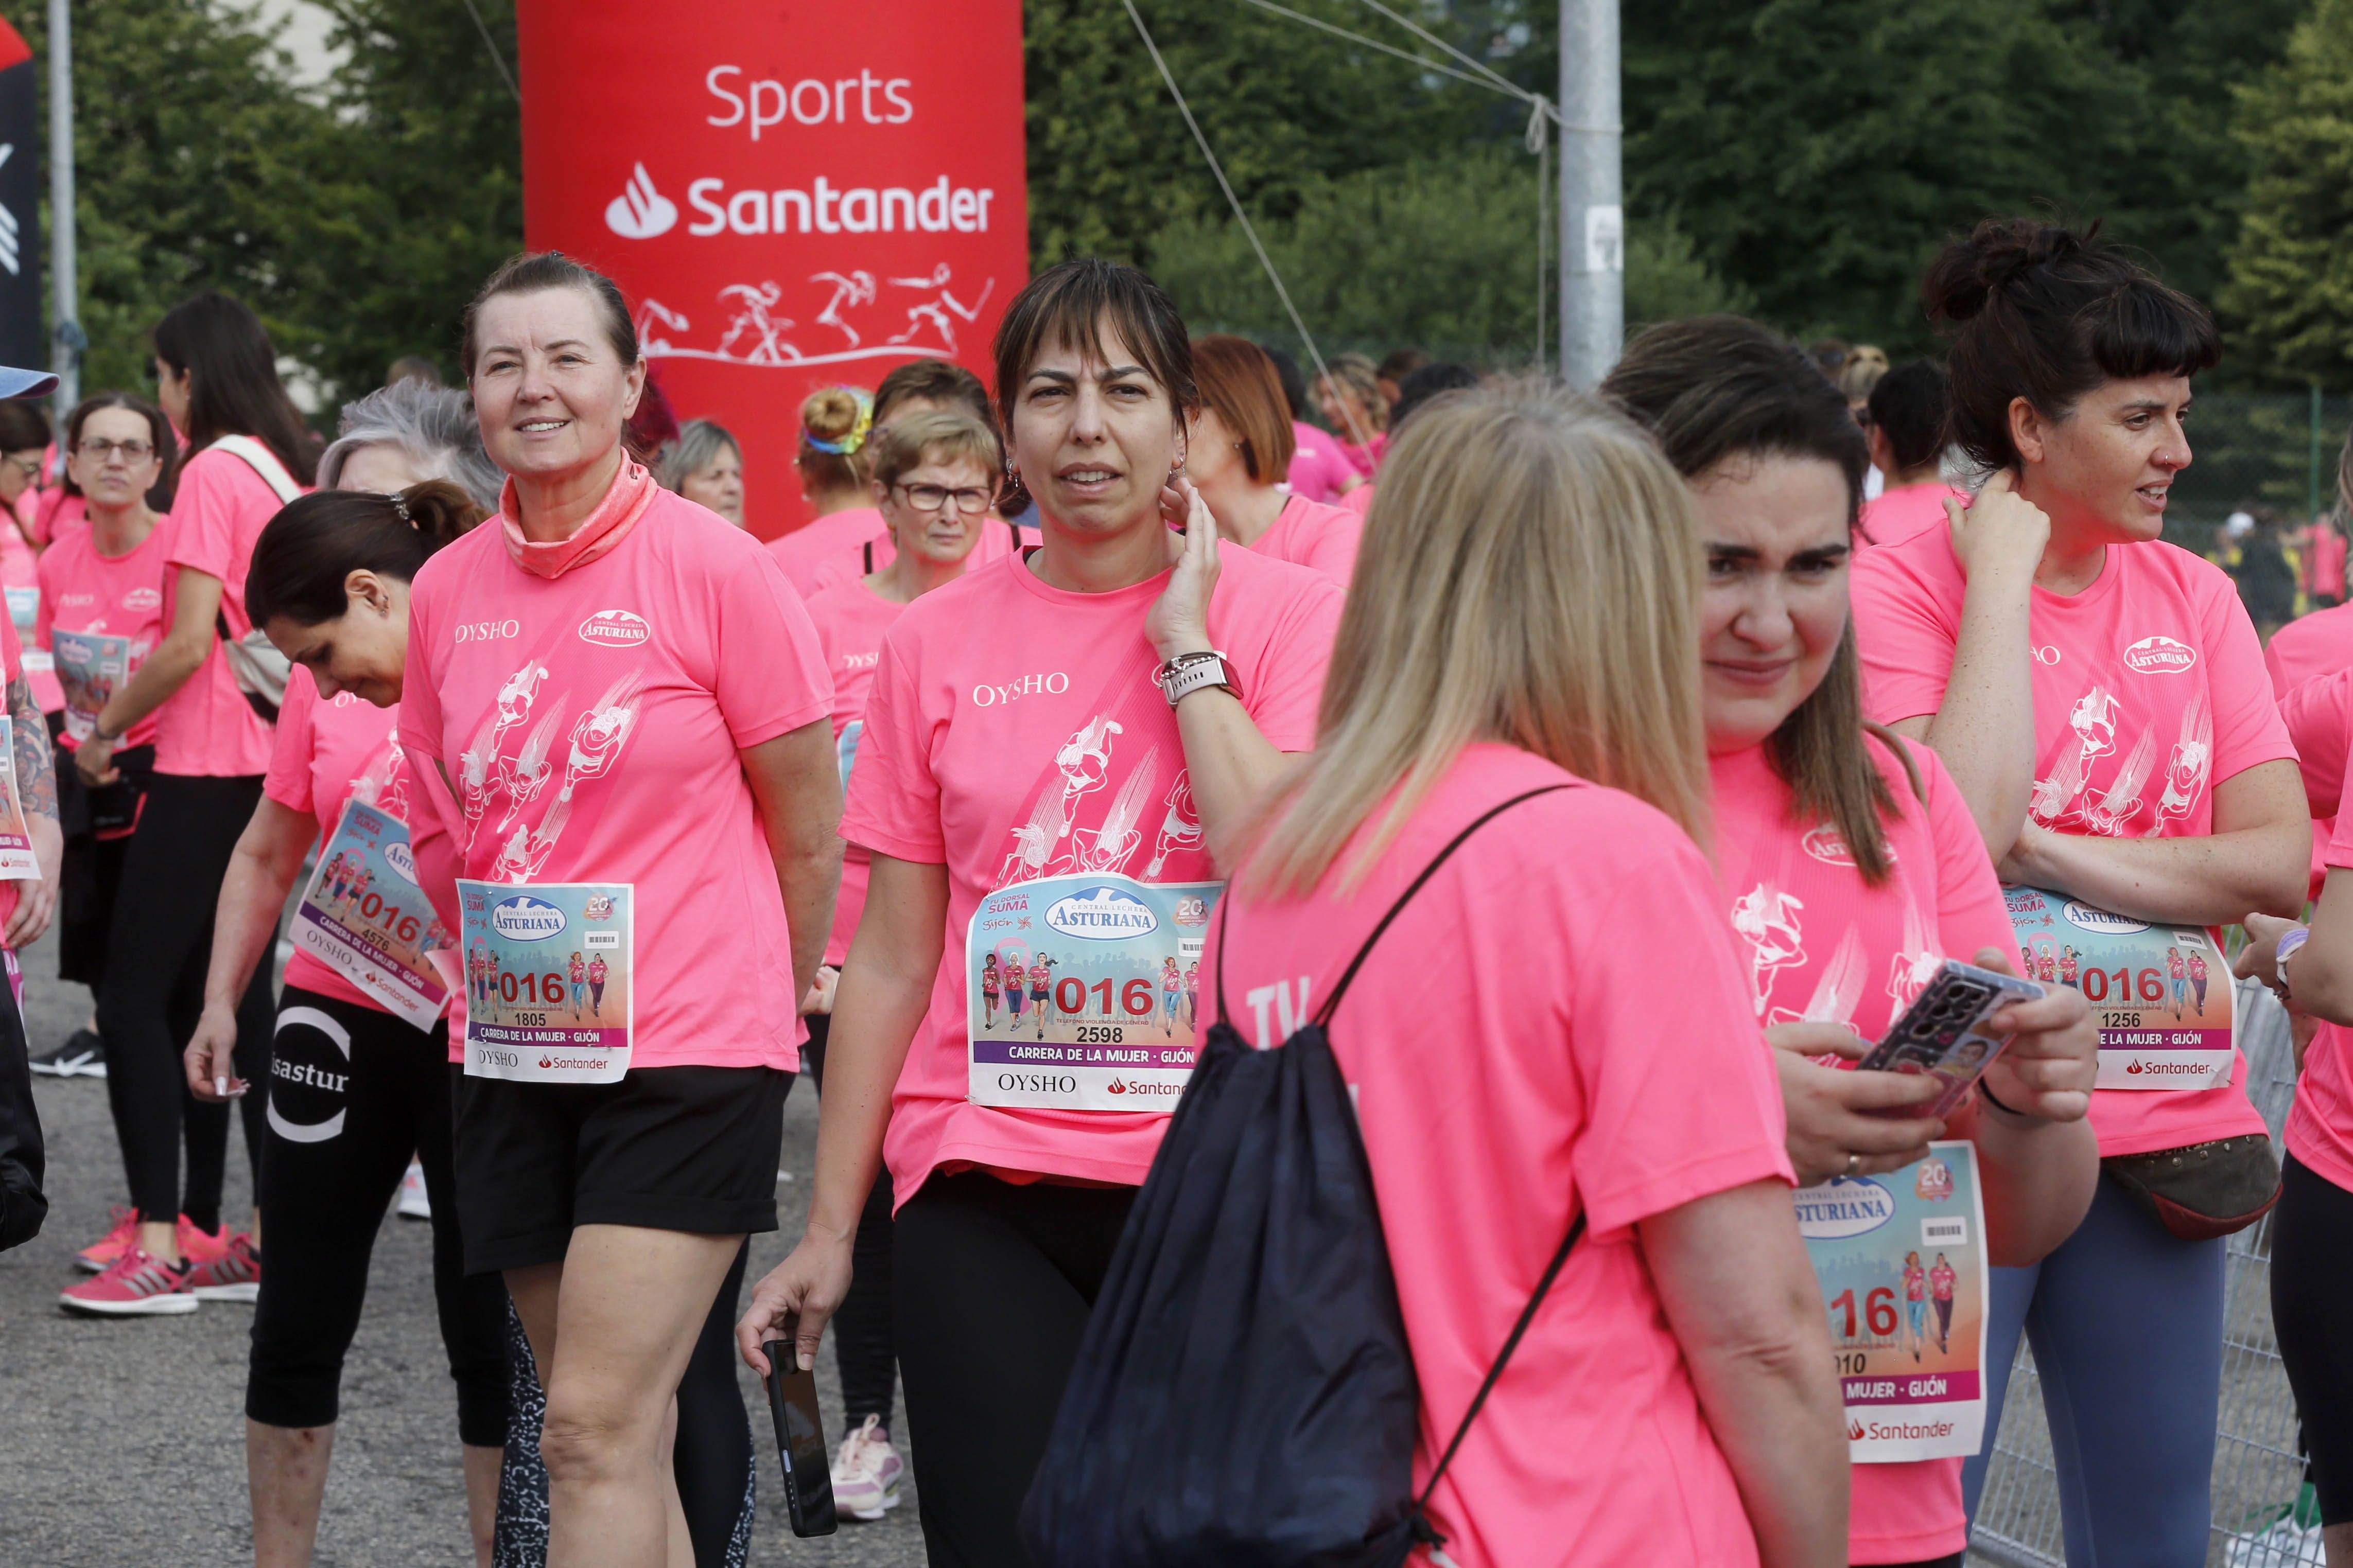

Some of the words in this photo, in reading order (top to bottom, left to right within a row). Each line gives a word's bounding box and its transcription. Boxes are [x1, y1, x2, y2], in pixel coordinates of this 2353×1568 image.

[706, 64, 913, 141] Sports
[688, 175, 994, 236] Santander
[455, 619, 519, 643] OYSHO
[583, 623, 644, 639] ASTURIANA
[2131, 652, 2191, 667] ASTURIANA
[973, 672, 1069, 707] OYSHO
[467, 900, 485, 912] SUMA
[988, 900, 1029, 914] SUMA
[1001, 893, 1030, 903] DORSAL
[2008, 899, 2046, 912] SUMA
[2015, 892, 2043, 904] DORSAL
[361, 892, 421, 942] 016
[496, 911, 560, 929] ASTURIANA
[1053, 906, 1152, 928] ASTURIANA
[307, 930, 353, 965] OYSHO
[319, 915, 352, 944] CARRERA
[352, 937, 362, 949] DE
[361, 942, 373, 956] LA
[372, 949, 399, 972] MUJER
[361, 928, 390, 952] 4576
[500, 971, 565, 1003] 016
[2082, 967, 2164, 1002] 016
[376, 978, 420, 1012] Santander
[1055, 977, 1154, 1015] 016
[515, 1013, 546, 1027] 1805
[2102, 1013, 2141, 1027] 1256
[481, 1027, 509, 1041] CARRERA
[510, 1031, 520, 1041] DE
[522, 1032, 533, 1041] LA
[535, 1032, 566, 1042] MUJER
[573, 1030, 600, 1042] GIJÓN
[1076, 1026, 1123, 1043] 2598
[2100, 1033, 2106, 1044] E
[2110, 1033, 2123, 1044] LA
[2127, 1033, 2162, 1045] MUJER
[2172, 1030, 2202, 1045] GIJÓN
[479, 1049, 518, 1067] OYSHO
[553, 1058, 608, 1069] Santander
[1009, 1046, 1064, 1061] CARRERA
[1067, 1048, 1083, 1061] DE
[1086, 1049, 1102, 1062] LA
[1106, 1049, 1149, 1063] MUJER
[1160, 1048, 1195, 1064] GIJÓN
[2145, 1062, 2210, 1074] Santander
[998, 1073, 1076, 1093] OYSHO
[1796, 1200, 1886, 1223] STURIANA
[1831, 1286, 1898, 1337] 16
[1846, 1381, 1896, 1400] MUJER
[1908, 1375, 1947, 1398] GIJÓN
[1869, 1420, 1954, 1440] Santander
